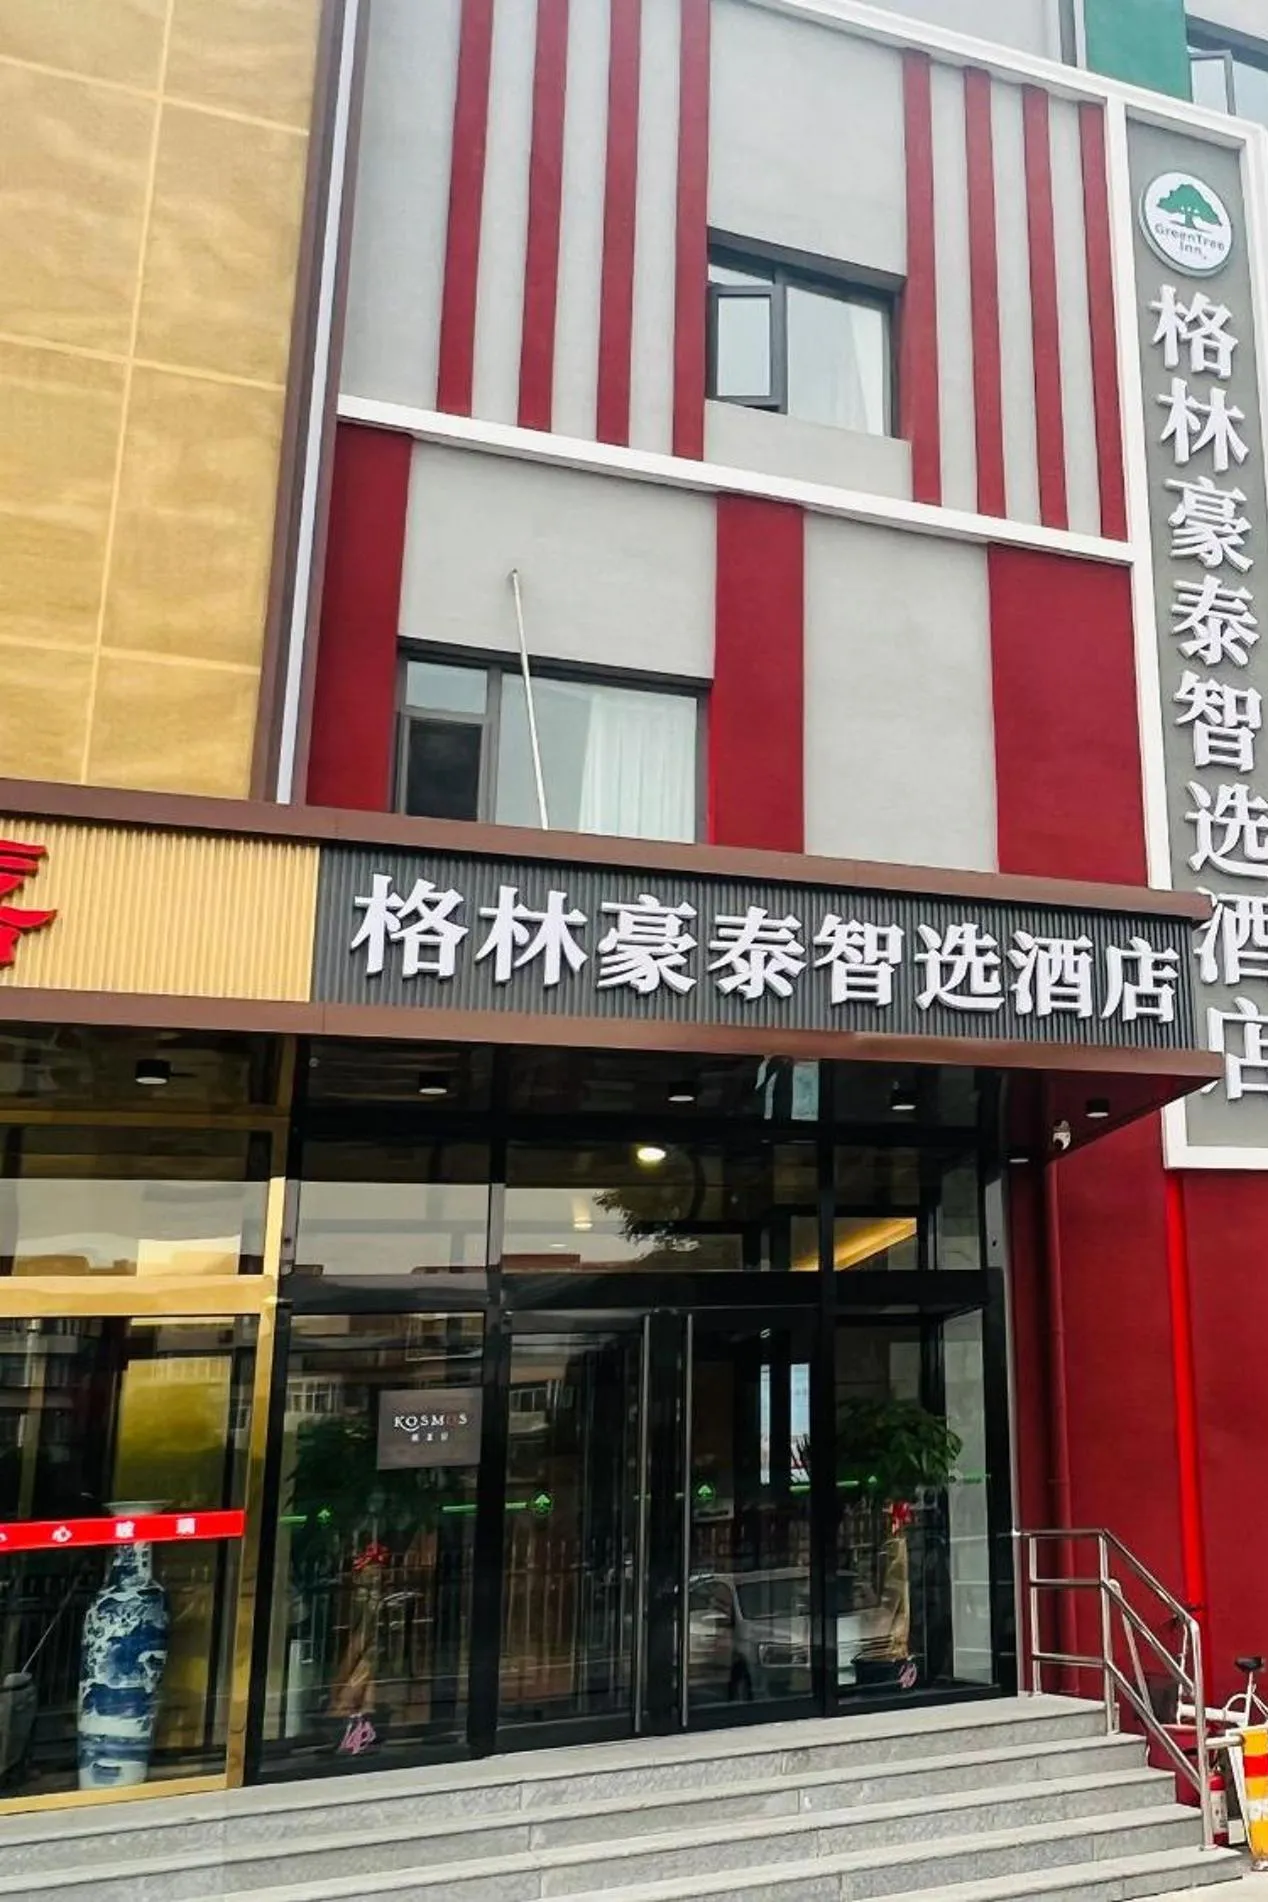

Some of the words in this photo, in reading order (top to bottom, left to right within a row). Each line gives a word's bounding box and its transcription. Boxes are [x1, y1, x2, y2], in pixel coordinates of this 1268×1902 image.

[1154, 223, 1225, 251] GreenTree
[350, 872, 1180, 1025] 格林豪泰智选酒店
